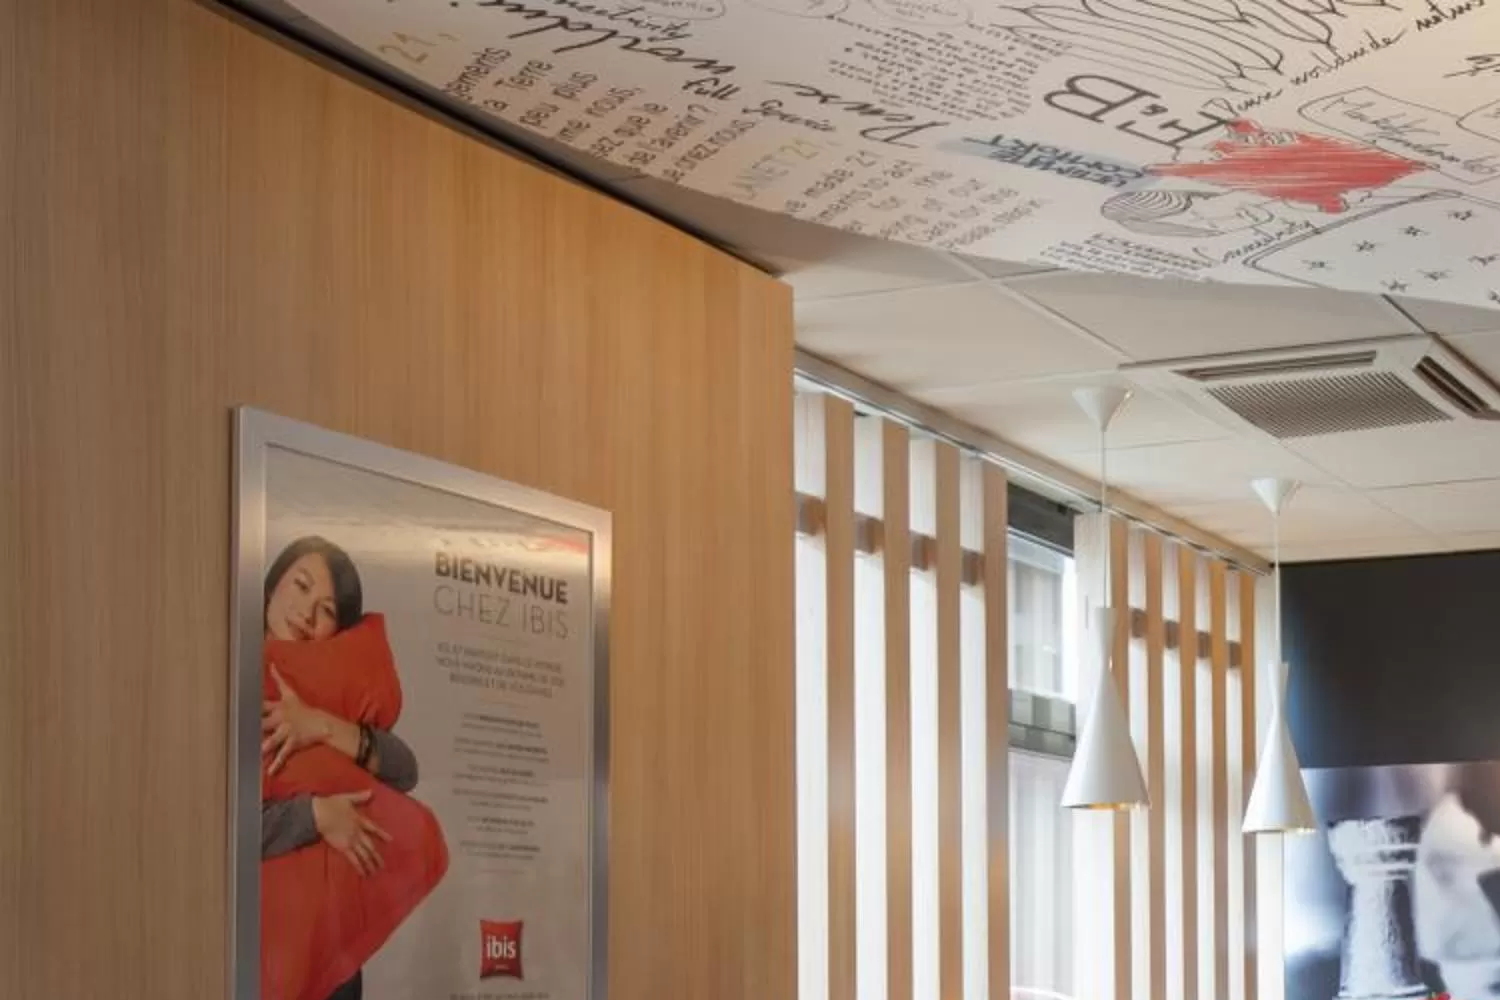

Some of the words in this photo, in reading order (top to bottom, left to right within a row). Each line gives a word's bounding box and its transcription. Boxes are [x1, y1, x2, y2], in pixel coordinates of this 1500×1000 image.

[434, 551, 569, 605] BIENVENUE
[433, 584, 511, 629] CHEZ
[521, 603, 570, 640] IBIS
[485, 935, 517, 960] ibis
